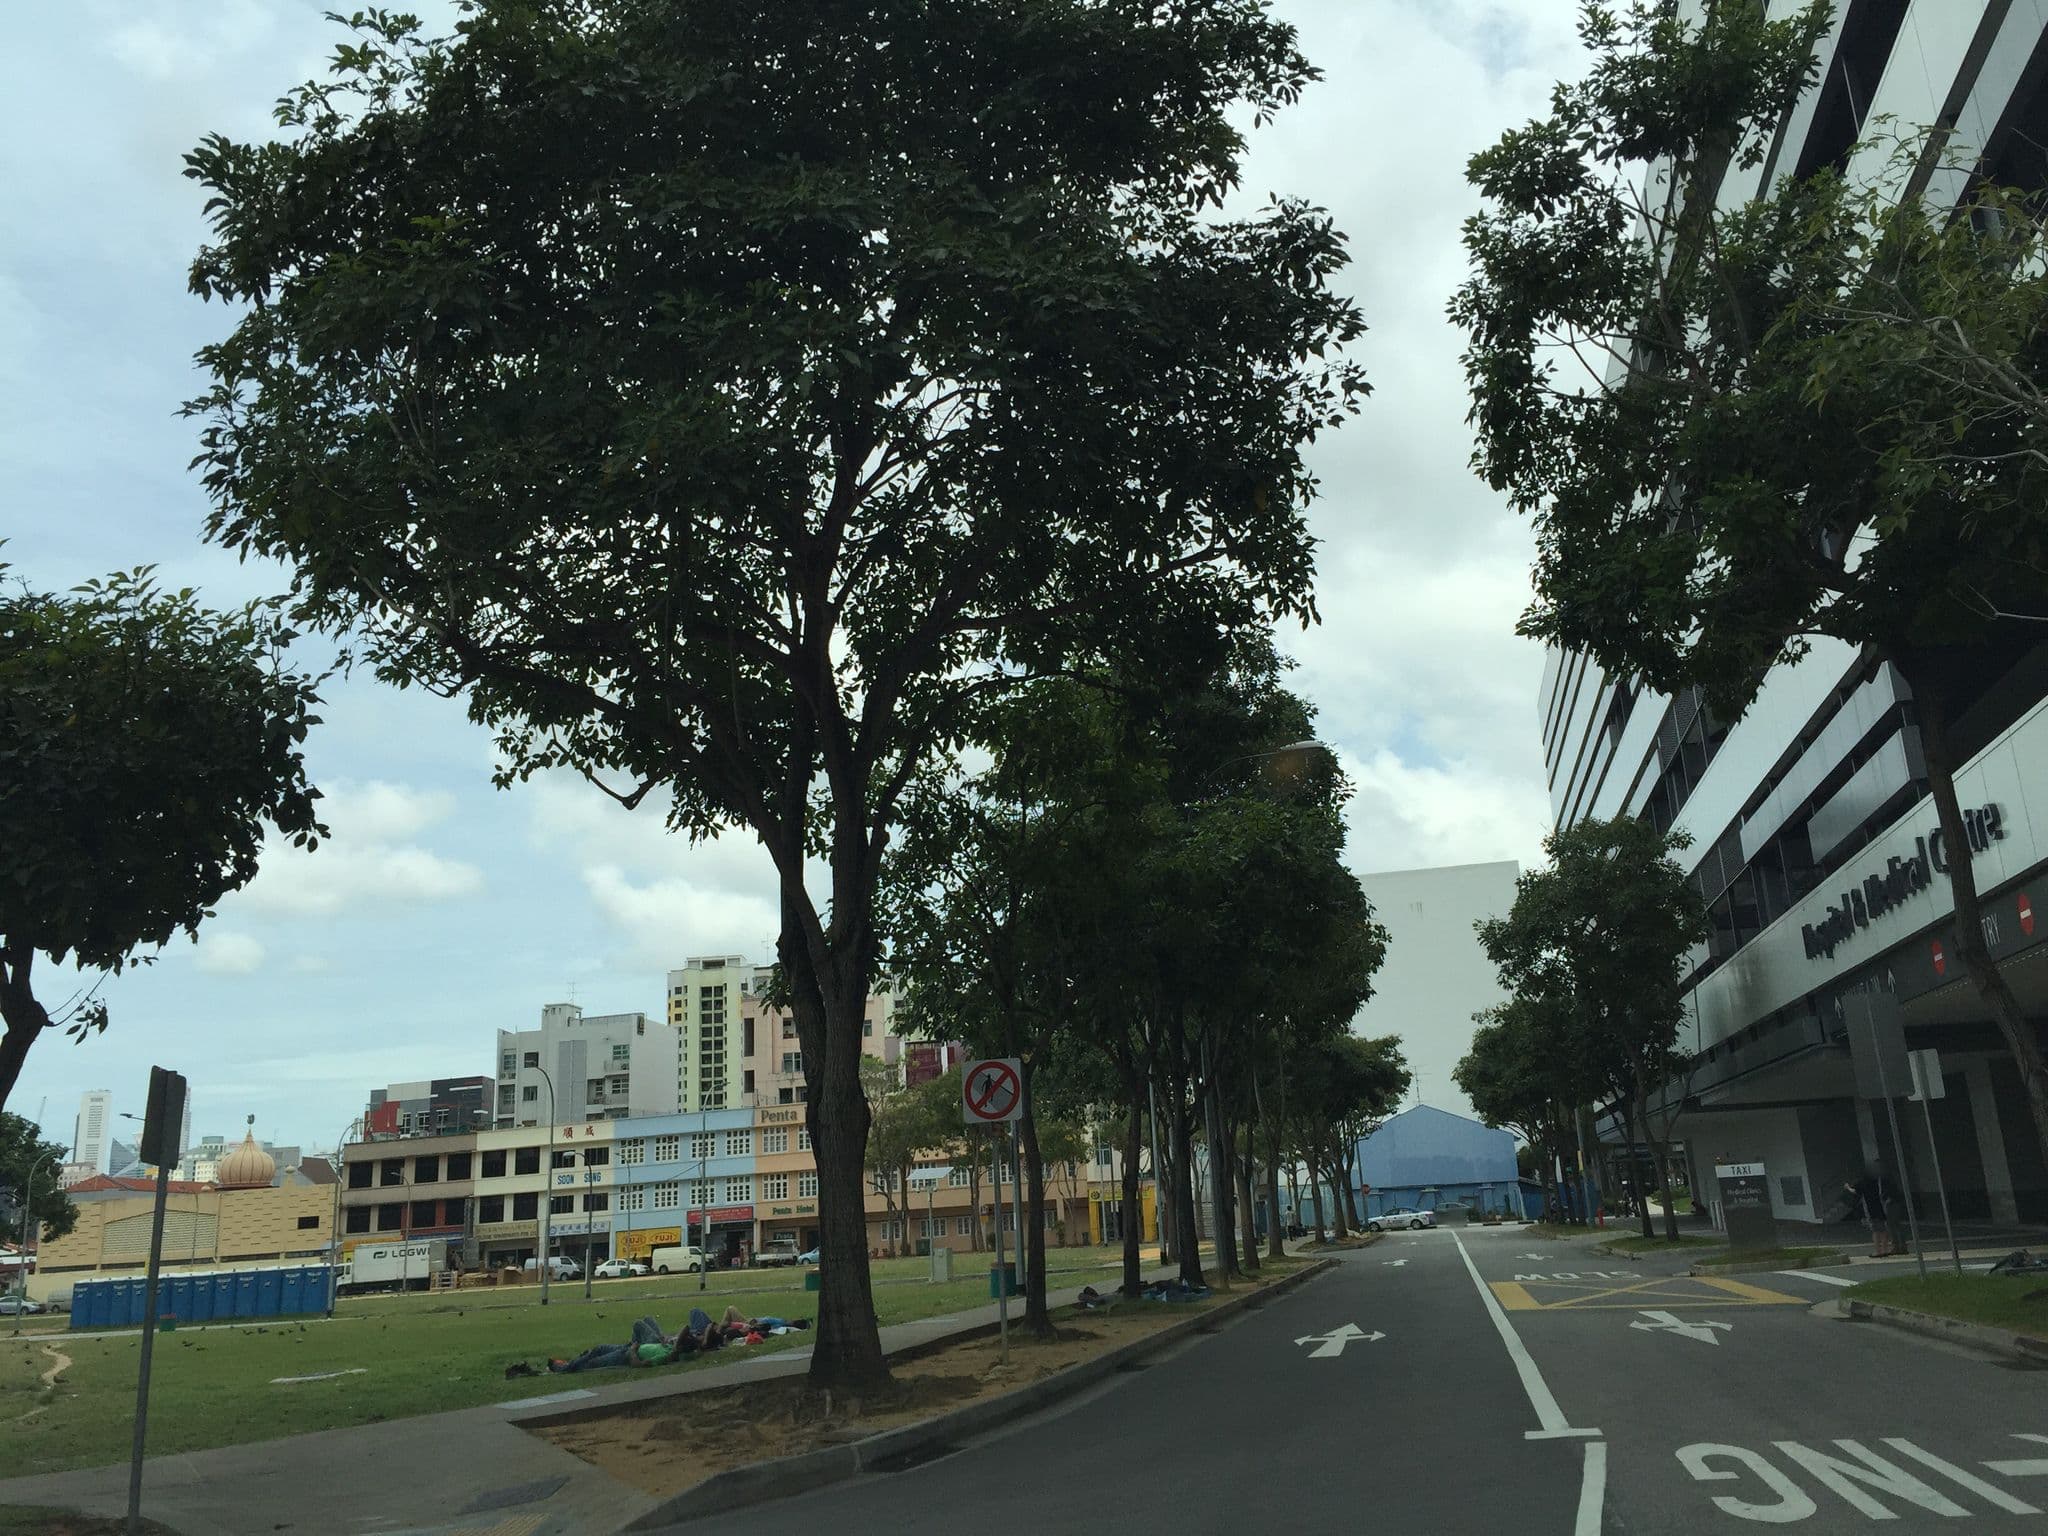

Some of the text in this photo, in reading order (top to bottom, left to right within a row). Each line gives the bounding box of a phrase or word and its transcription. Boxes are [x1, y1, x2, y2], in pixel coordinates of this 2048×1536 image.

[761, 1109, 798, 1123] Penta
[1731, 1165, 1752, 1175] TAXI
[558, 1174, 574, 1185] SOON
[772, 1203, 815, 1215] Penta Hotel
[655, 1234, 673, 1242] FUJI
[392, 1247, 431, 1258] LOGWI
[1514, 1271, 1642, 1280] SLOW
